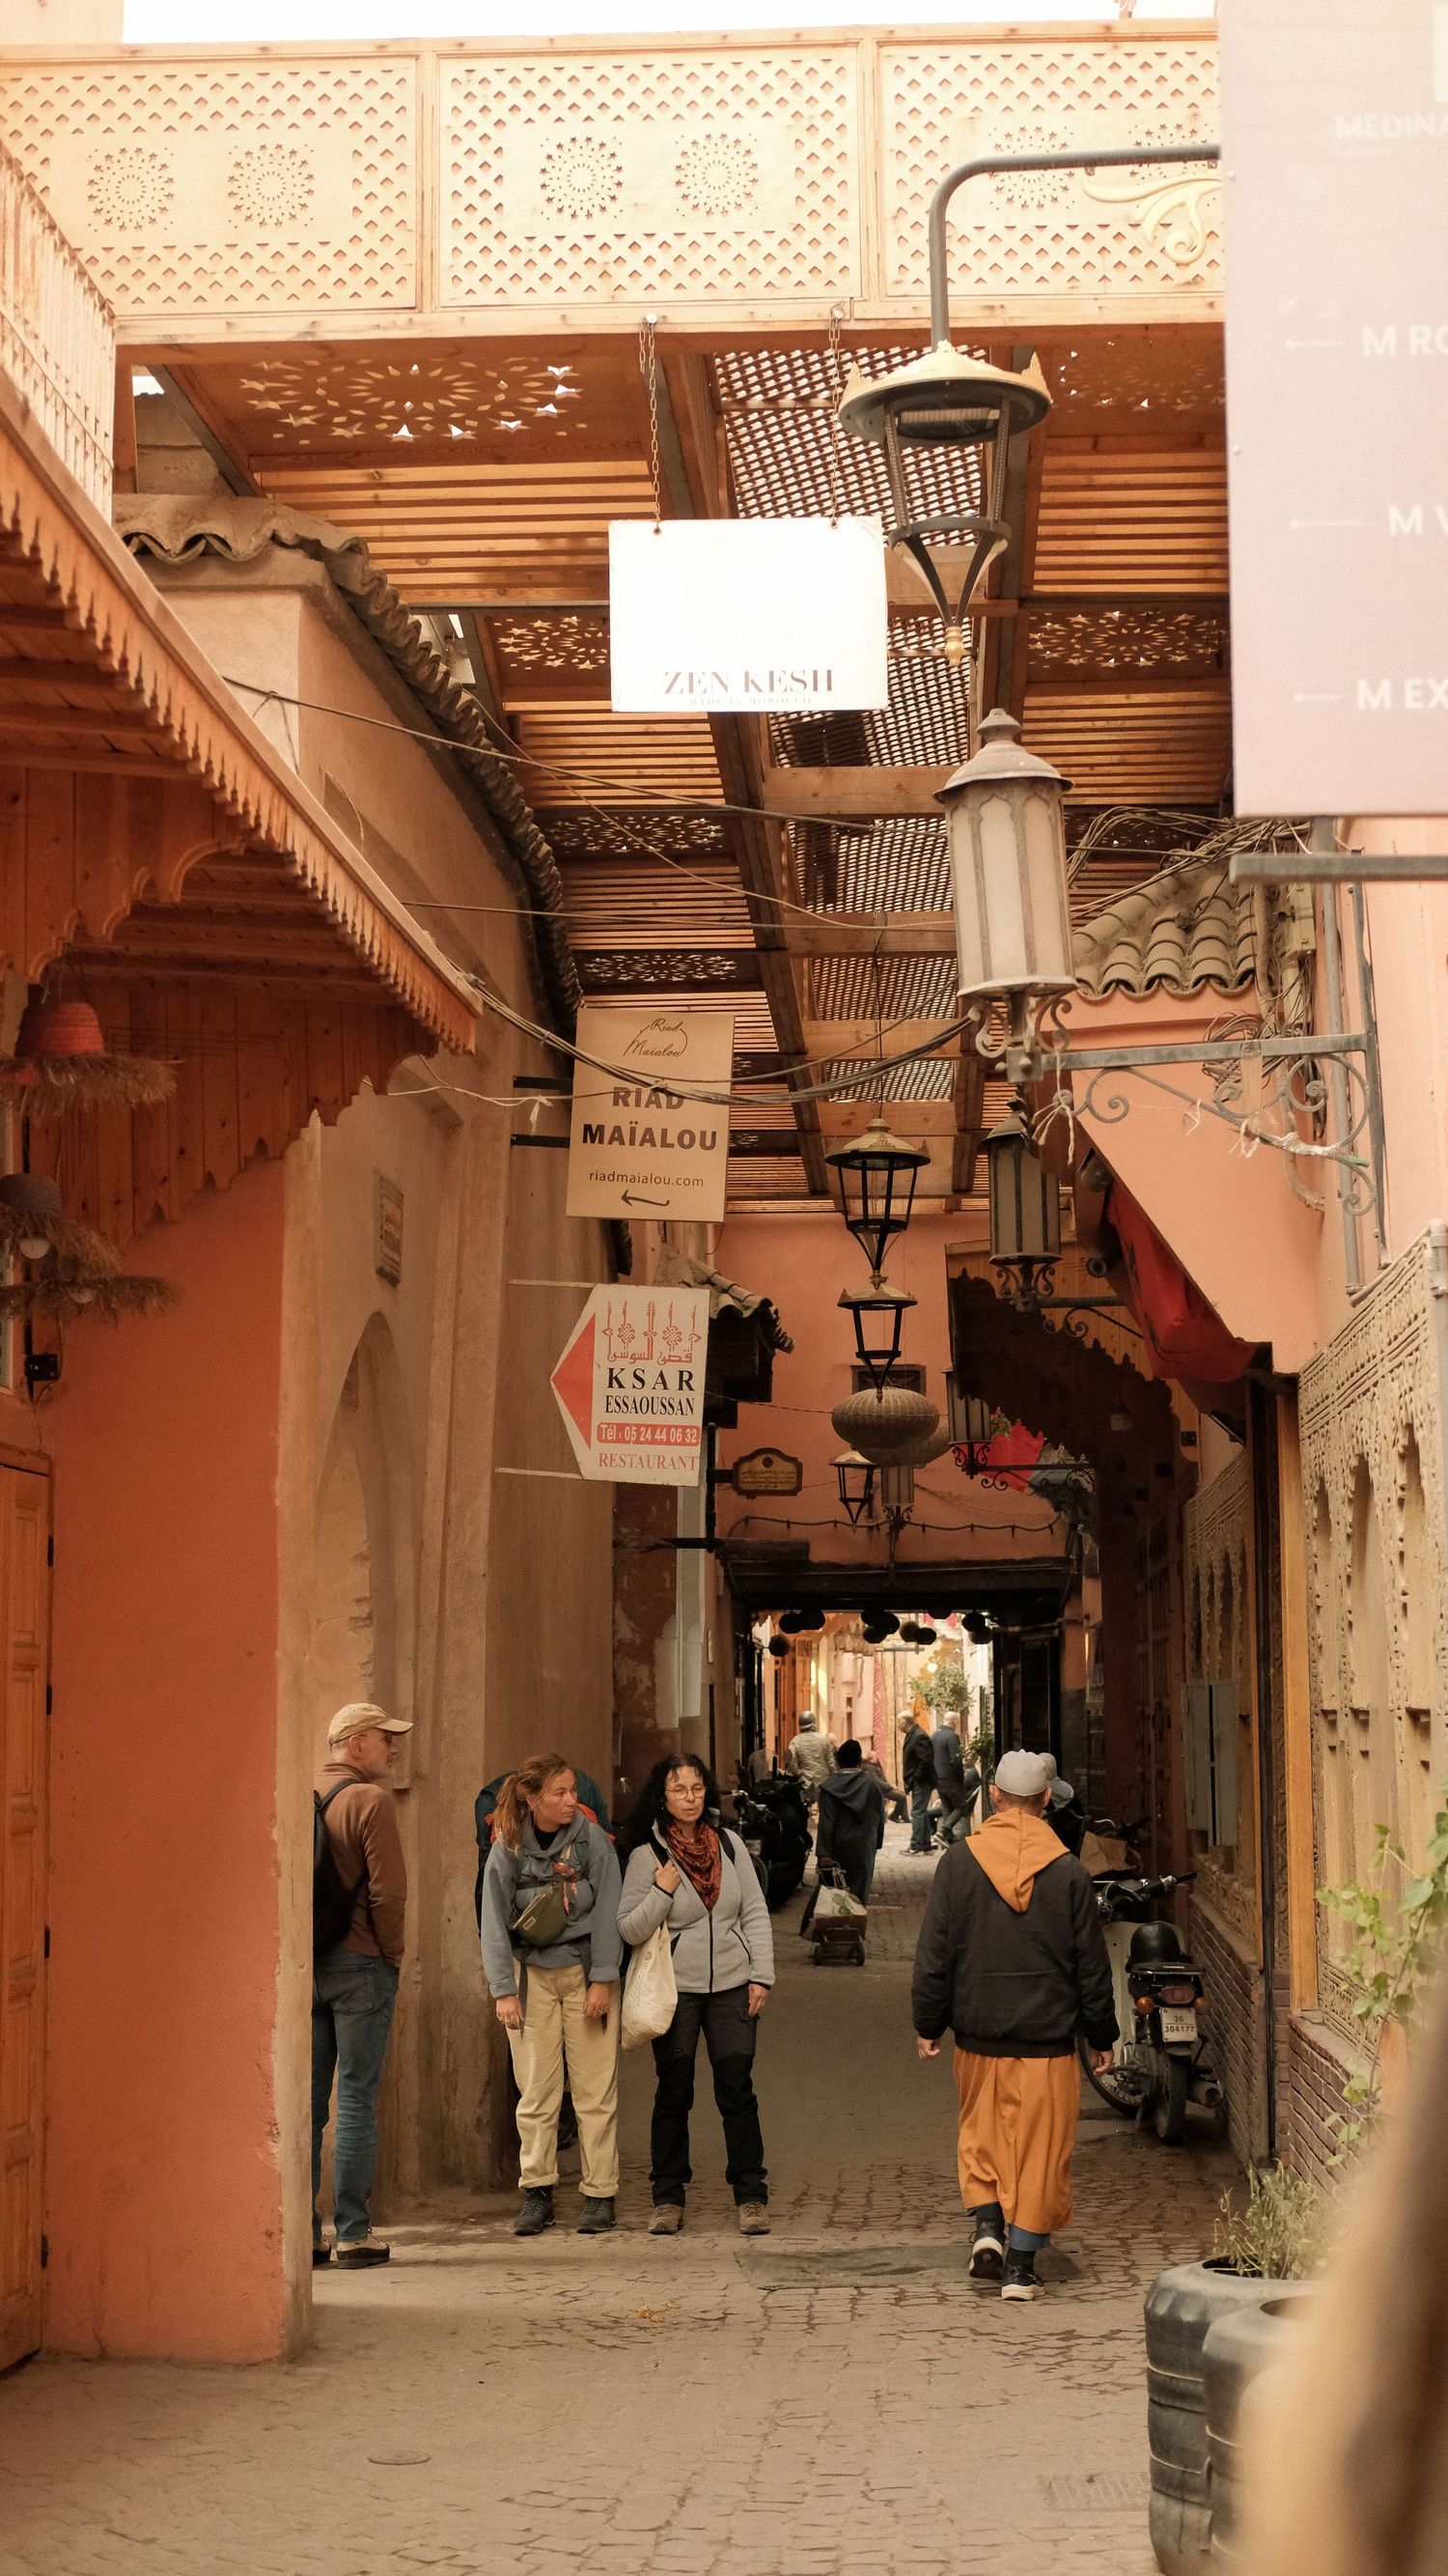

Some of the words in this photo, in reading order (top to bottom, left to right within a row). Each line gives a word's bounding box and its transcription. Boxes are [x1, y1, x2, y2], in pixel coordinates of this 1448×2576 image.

[1362, 324, 1397, 356] M
[1388, 503, 1423, 536] M
[664, 670, 730, 695] ZEN
[743, 668, 833, 693] KESH
[1355, 678, 1391, 711] M
[650, 1018, 684, 1032] Riad
[612, 1086, 685, 1110] RIAD
[582, 1120, 717, 1152] MAÏALOU
[589, 1170, 704, 1188] riadmaialou.com
[607, 1367, 696, 1391] KSAR
[604, 1394, 696, 1416] ESSAOUSSAN
[625, 1426, 637, 1442] 05
[639, 1427, 652, 1442] 24
[654, 1427, 667, 1442] 44
[670, 1428, 682, 1442] 06
[684, 1428, 697, 1443] 32
[599, 1452, 698, 1470] RESTAURANT
